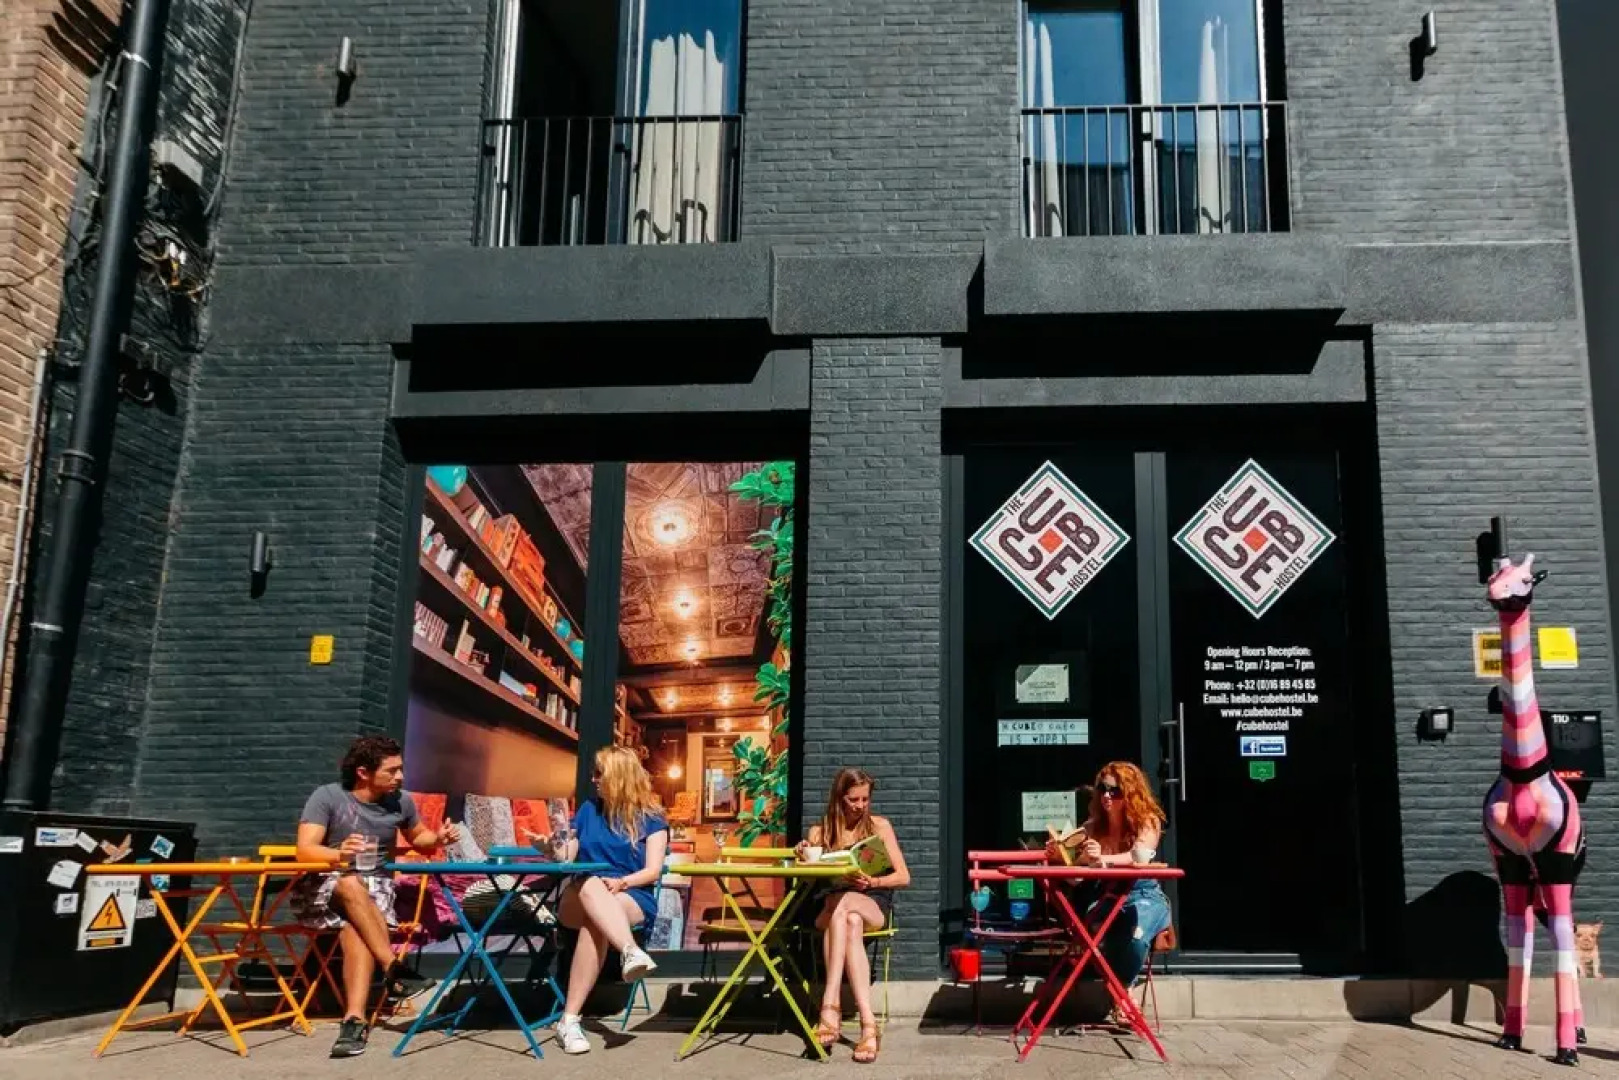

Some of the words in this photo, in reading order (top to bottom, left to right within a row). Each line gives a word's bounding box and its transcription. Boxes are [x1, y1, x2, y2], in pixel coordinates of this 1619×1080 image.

[1003, 496, 1024, 516] THE
[1208, 495, 1230, 515] THE
[1067, 557, 1104, 592] HOSTEL
[1273, 555, 1311, 591] HOSTEL
[1207, 645, 1240, 658] Opening
[1242, 645, 1266, 656] Hours
[1204, 660, 1210, 671] 9
[1211, 661, 1225, 670] am
[1235, 660, 1243, 670] 12
[1244, 661, 1258, 672] pm
[1264, 660, 1270, 670] 3
[1271, 661, 1284, 672] pm
[1295, 659, 1300, 670] 7
[1301, 661, 1315, 672] pm
[1205, 679, 1235, 691] Phone:
[1236, 679, 1255, 690] +32
[1256, 679, 1278, 691] (0)16
[1292, 679, 1303, 690] 45
[1203, 693, 1229, 703] Email:
[1230, 693, 1319, 704] hello@cubehostel.be
[1220, 706, 1303, 717] www.cubehostel.be
[1236, 720, 1289, 731] #cubehostel
